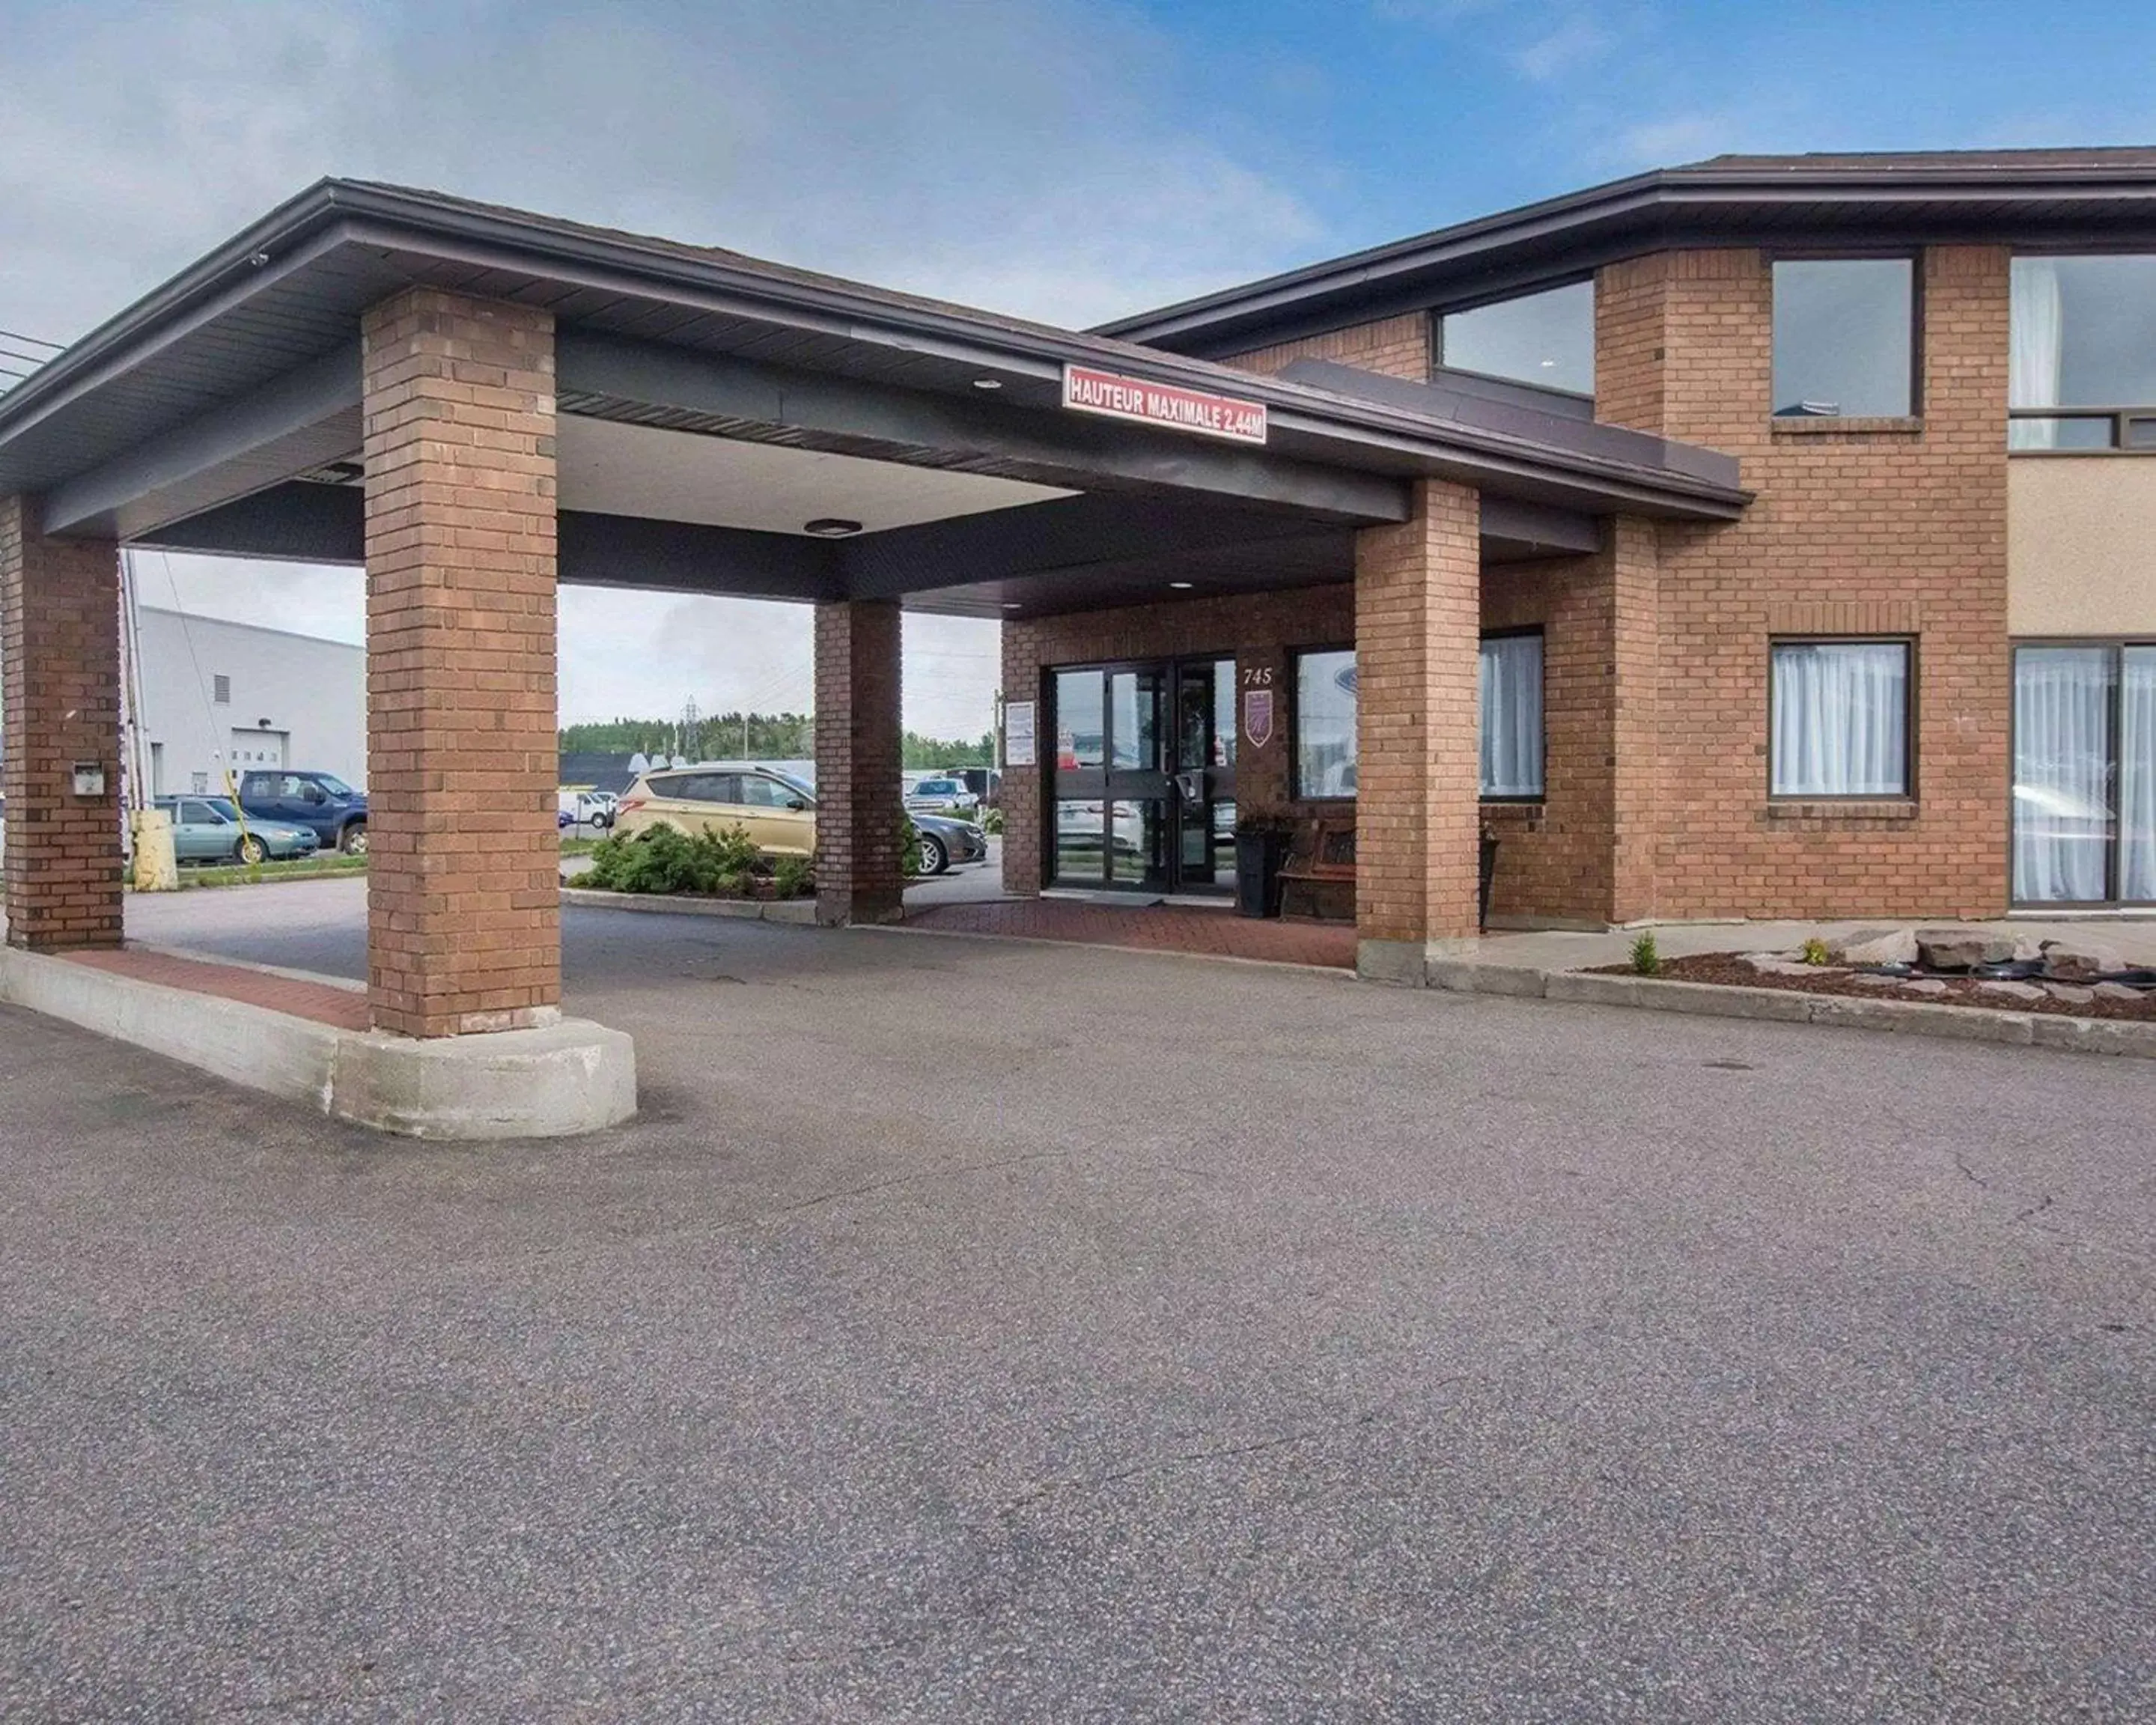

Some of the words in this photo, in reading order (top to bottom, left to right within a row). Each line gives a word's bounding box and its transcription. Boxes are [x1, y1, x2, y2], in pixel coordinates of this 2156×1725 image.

[1071, 377, 1144, 413] HAUTEUR
[1147, 392, 1220, 430] MAXIMALE
[1244, 668, 1272, 684] 745
